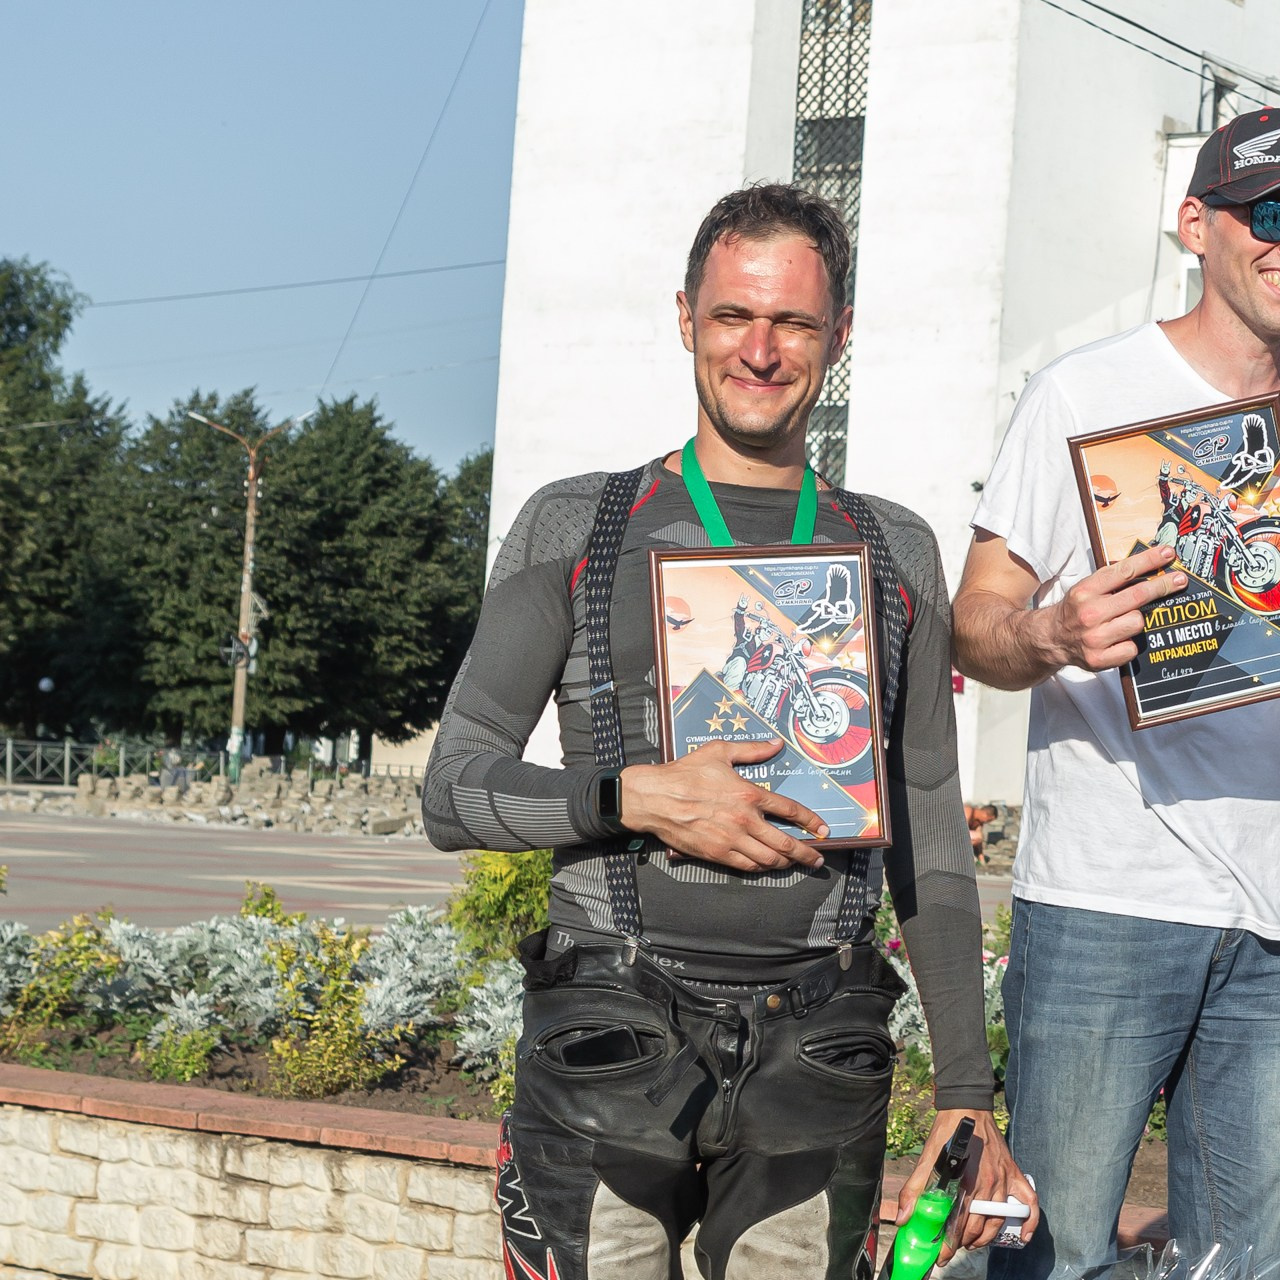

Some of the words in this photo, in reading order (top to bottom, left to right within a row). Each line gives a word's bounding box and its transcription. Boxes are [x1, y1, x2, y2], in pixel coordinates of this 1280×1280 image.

[1196, 453, 1233, 467] GYMKHANA
[775, 598, 814, 607] GYMKHANA
[1166, 597, 1174, 606] GP
[1175, 593, 1191, 604] 2024:
[1197, 590, 1213, 599] ЭТАП
[1148, 634, 1165, 649] ЗА
[1166, 631, 1174, 645] 1
[1174, 621, 1213, 643] МЕСТО
[1149, 638, 1219, 664] НАГРАЖДАЕТСЯ
[723, 733, 733, 741] GP
[733, 732, 751, 741] 2024:
[751, 732, 756, 740] 3
[756, 732, 773, 740] ЭТАП
[738, 765, 768, 780] ЕСТО
